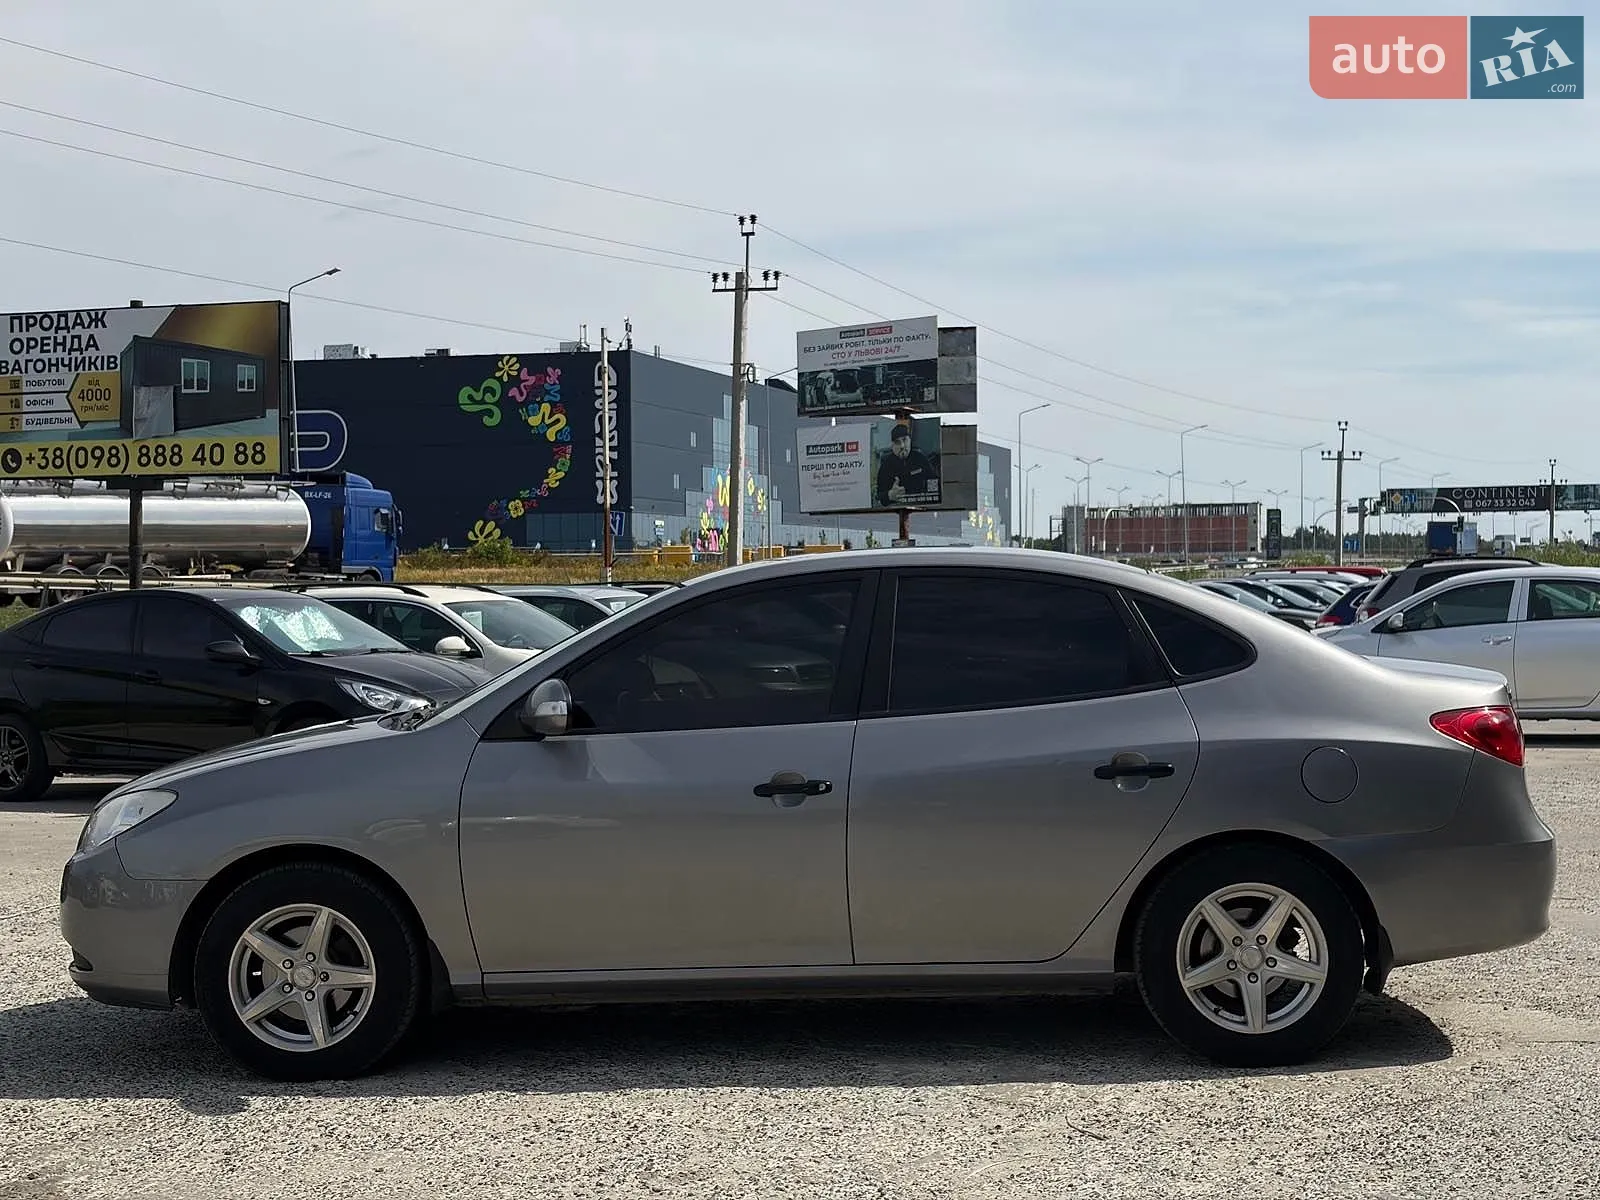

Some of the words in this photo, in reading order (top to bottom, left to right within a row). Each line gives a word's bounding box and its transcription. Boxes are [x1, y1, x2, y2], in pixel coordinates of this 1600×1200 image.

[9, 311, 108, 334] ПРОДАЖ
[9, 334, 100, 355] ОРЕНДА
[817, 342, 843, 352] ЗАЙВИХ
[868, 336, 892, 346] ТІЛЬКИ
[893, 335, 904, 343] ПО
[831, 351, 847, 360] СТО
[854, 347, 883, 357] ЛЬВОВІ
[885, 345, 901, 354] 24/7
[0, 355, 118, 375] ВАГОНЧИКІВ
[25, 378, 65, 388] ПОБУТОВІ
[88, 379, 100, 387] від
[77, 387, 111, 402] 4000
[25, 398, 54, 408] ОФІСНІ
[80, 402, 110, 414] грн/міс
[25, 416, 73, 427] БУДІВЕЛЬНІ
[808, 445, 842, 454] Autopark
[25, 443, 130, 474] +38(098)
[137, 443, 184, 468] 888
[191, 442, 225, 466] 40
[233, 441, 266, 466] 88
[1452, 487, 1547, 499] CONTINENT
[1475, 499, 1492, 507] 067
[1506, 499, 1517, 507] 32
[1518, 498, 1536, 507] 043
